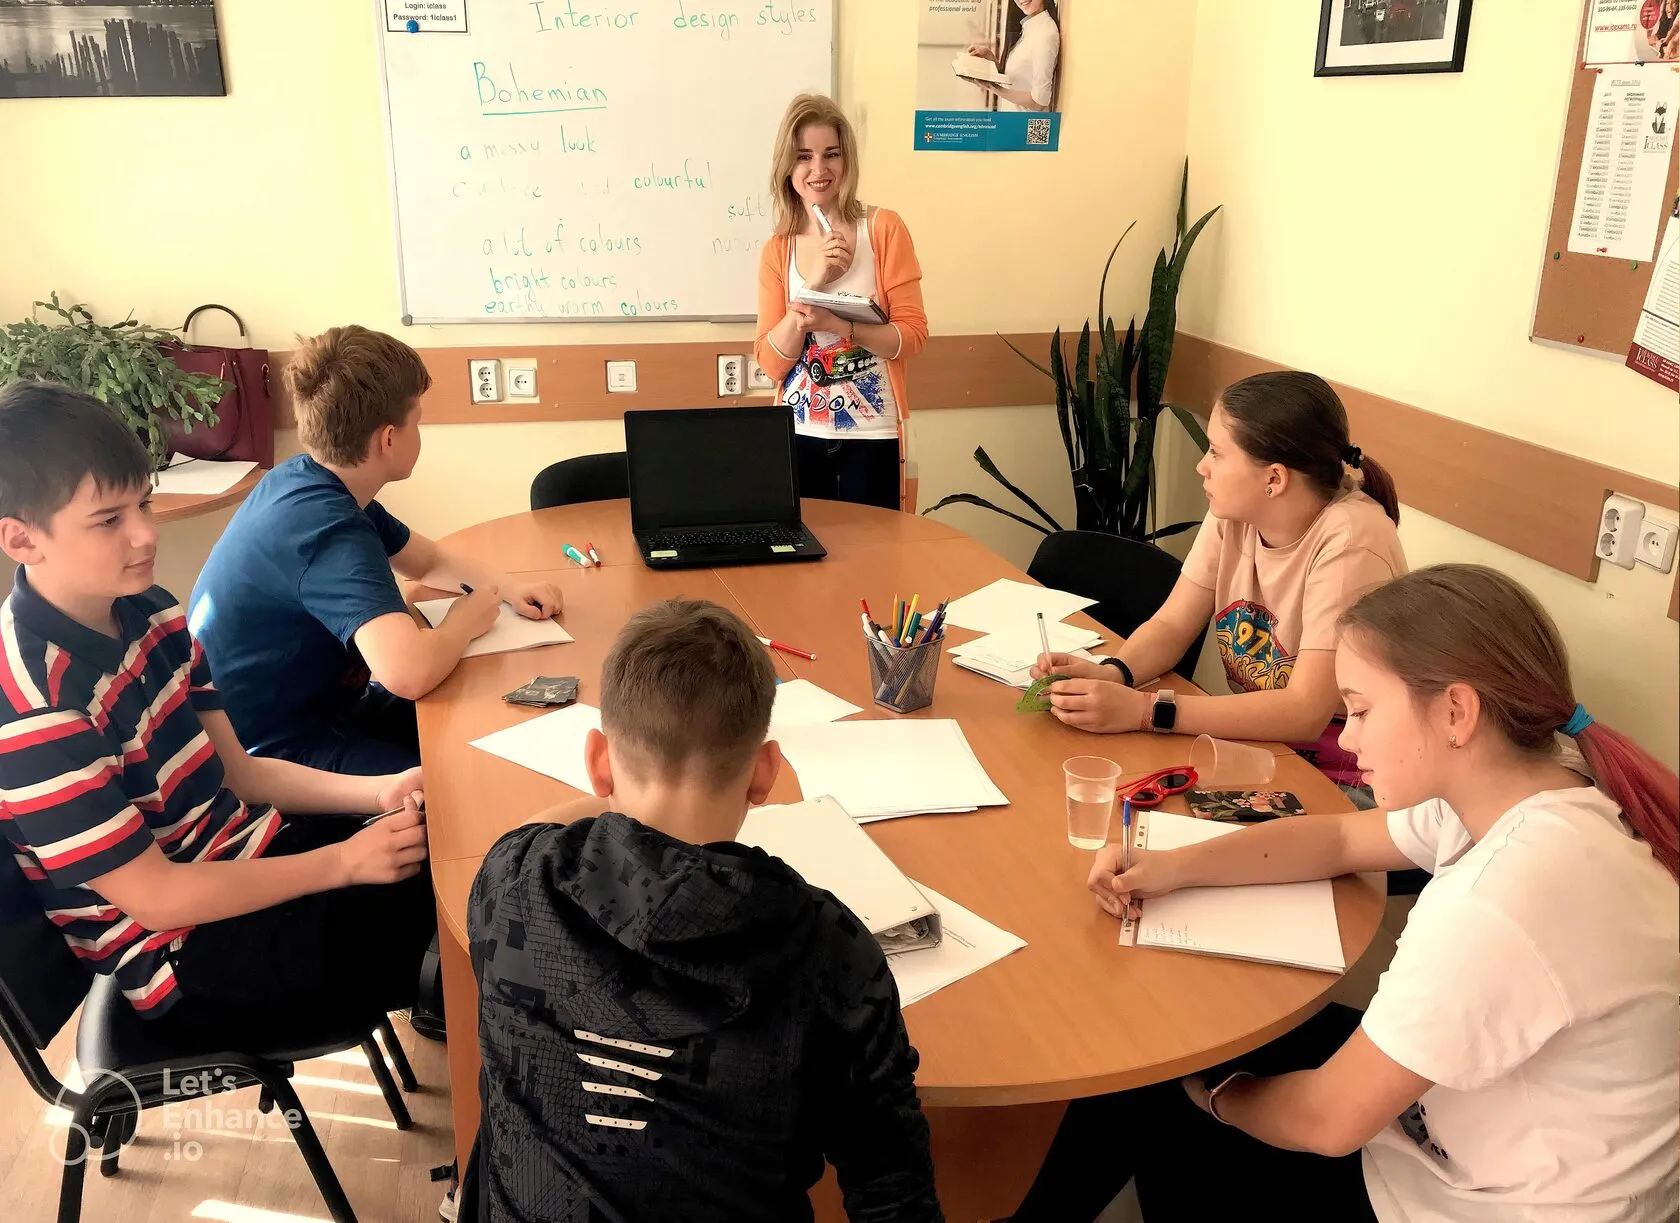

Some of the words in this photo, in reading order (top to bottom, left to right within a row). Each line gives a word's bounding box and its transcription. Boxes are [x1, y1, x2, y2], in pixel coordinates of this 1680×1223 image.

[405, 2, 425, 10] Login:
[529, 0, 639, 33] Interior
[673, 0, 739, 40] design
[757, 0, 816, 35] styles
[474, 61, 608, 106] Bohemian
[460, 145, 471, 160] a
[634, 158, 712, 192] colourful
[483, 238, 495, 256] a
[579, 223, 642, 255] colours
[489, 266, 550, 301] bright
[620, 288, 680, 316] colours
